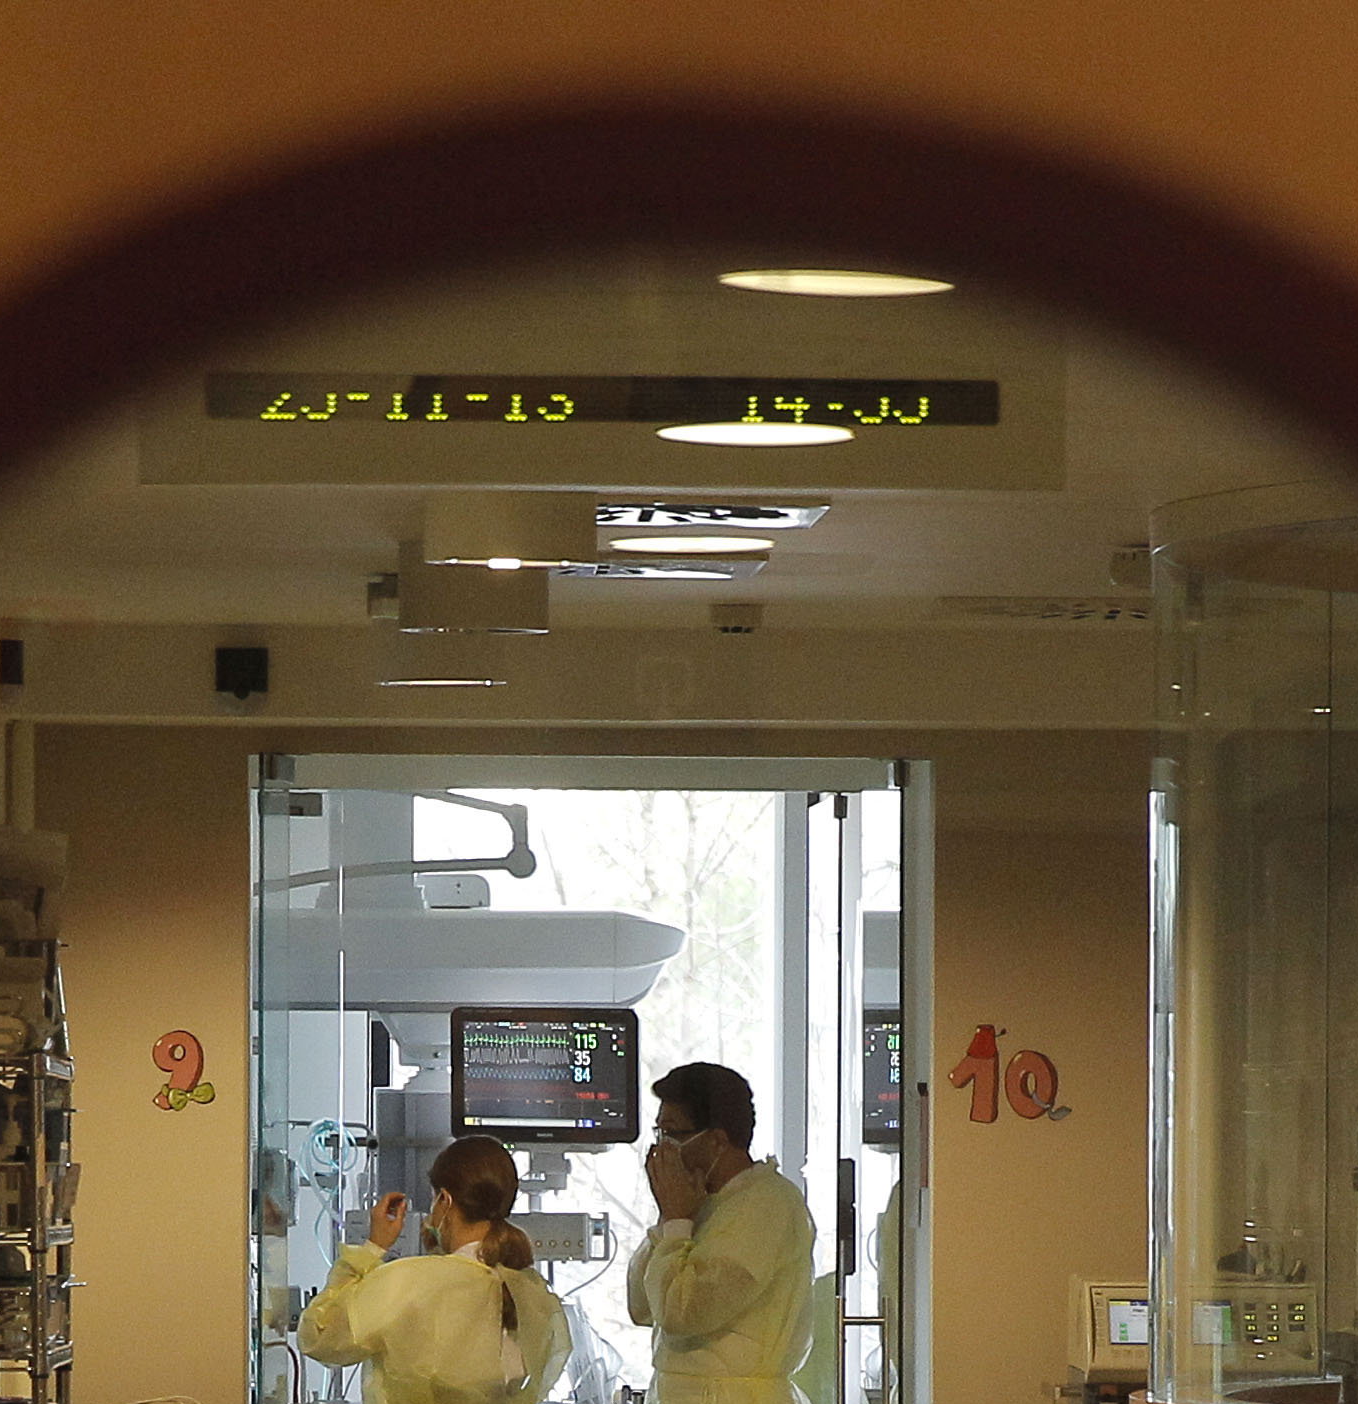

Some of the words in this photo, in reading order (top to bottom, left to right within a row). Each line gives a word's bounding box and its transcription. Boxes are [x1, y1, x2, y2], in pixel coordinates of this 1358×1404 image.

[574, 1034, 598, 1049] 115
[574, 1051, 591, 1066] 35
[152, 1029, 204, 1110] 9
[574, 1067, 591, 1082] 84
[947, 1024, 1059, 1123] 10
